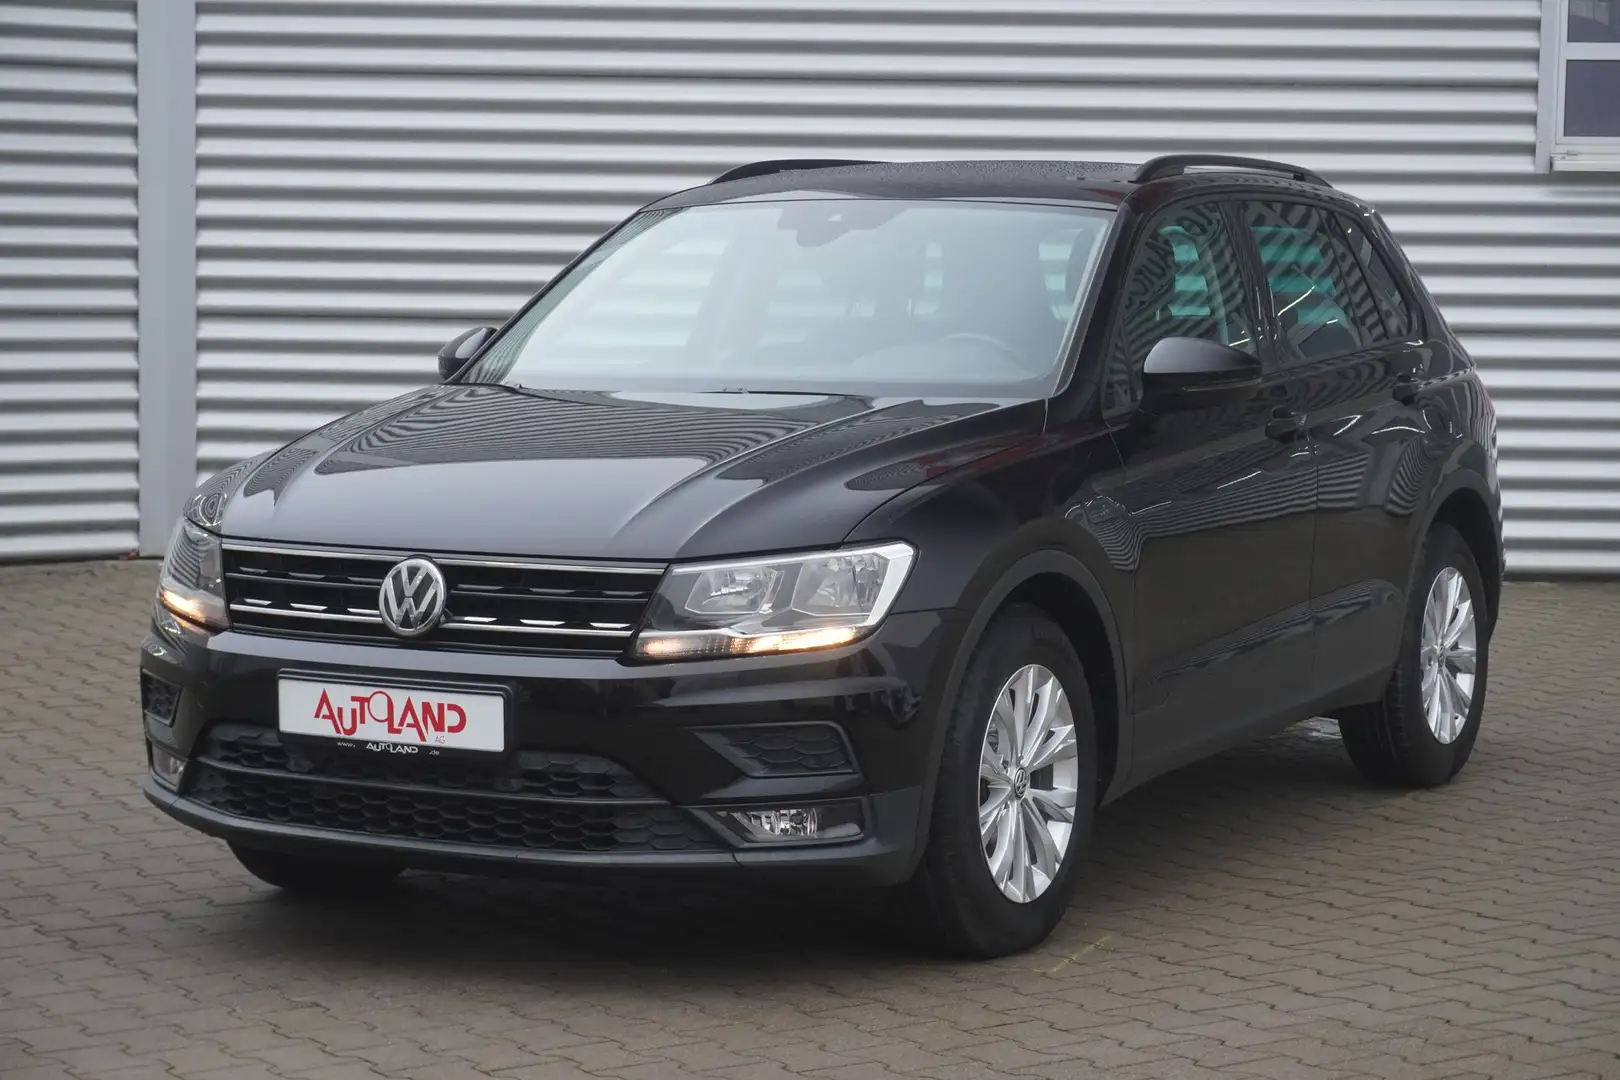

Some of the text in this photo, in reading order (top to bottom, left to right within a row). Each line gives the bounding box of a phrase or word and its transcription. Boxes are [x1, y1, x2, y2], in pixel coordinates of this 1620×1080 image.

[380, 560, 442, 634] VW
[314, 688, 467, 742] AUTOLAND
[366, 742, 418, 754] AUTOLAND
[435, 735, 445, 744] AG
